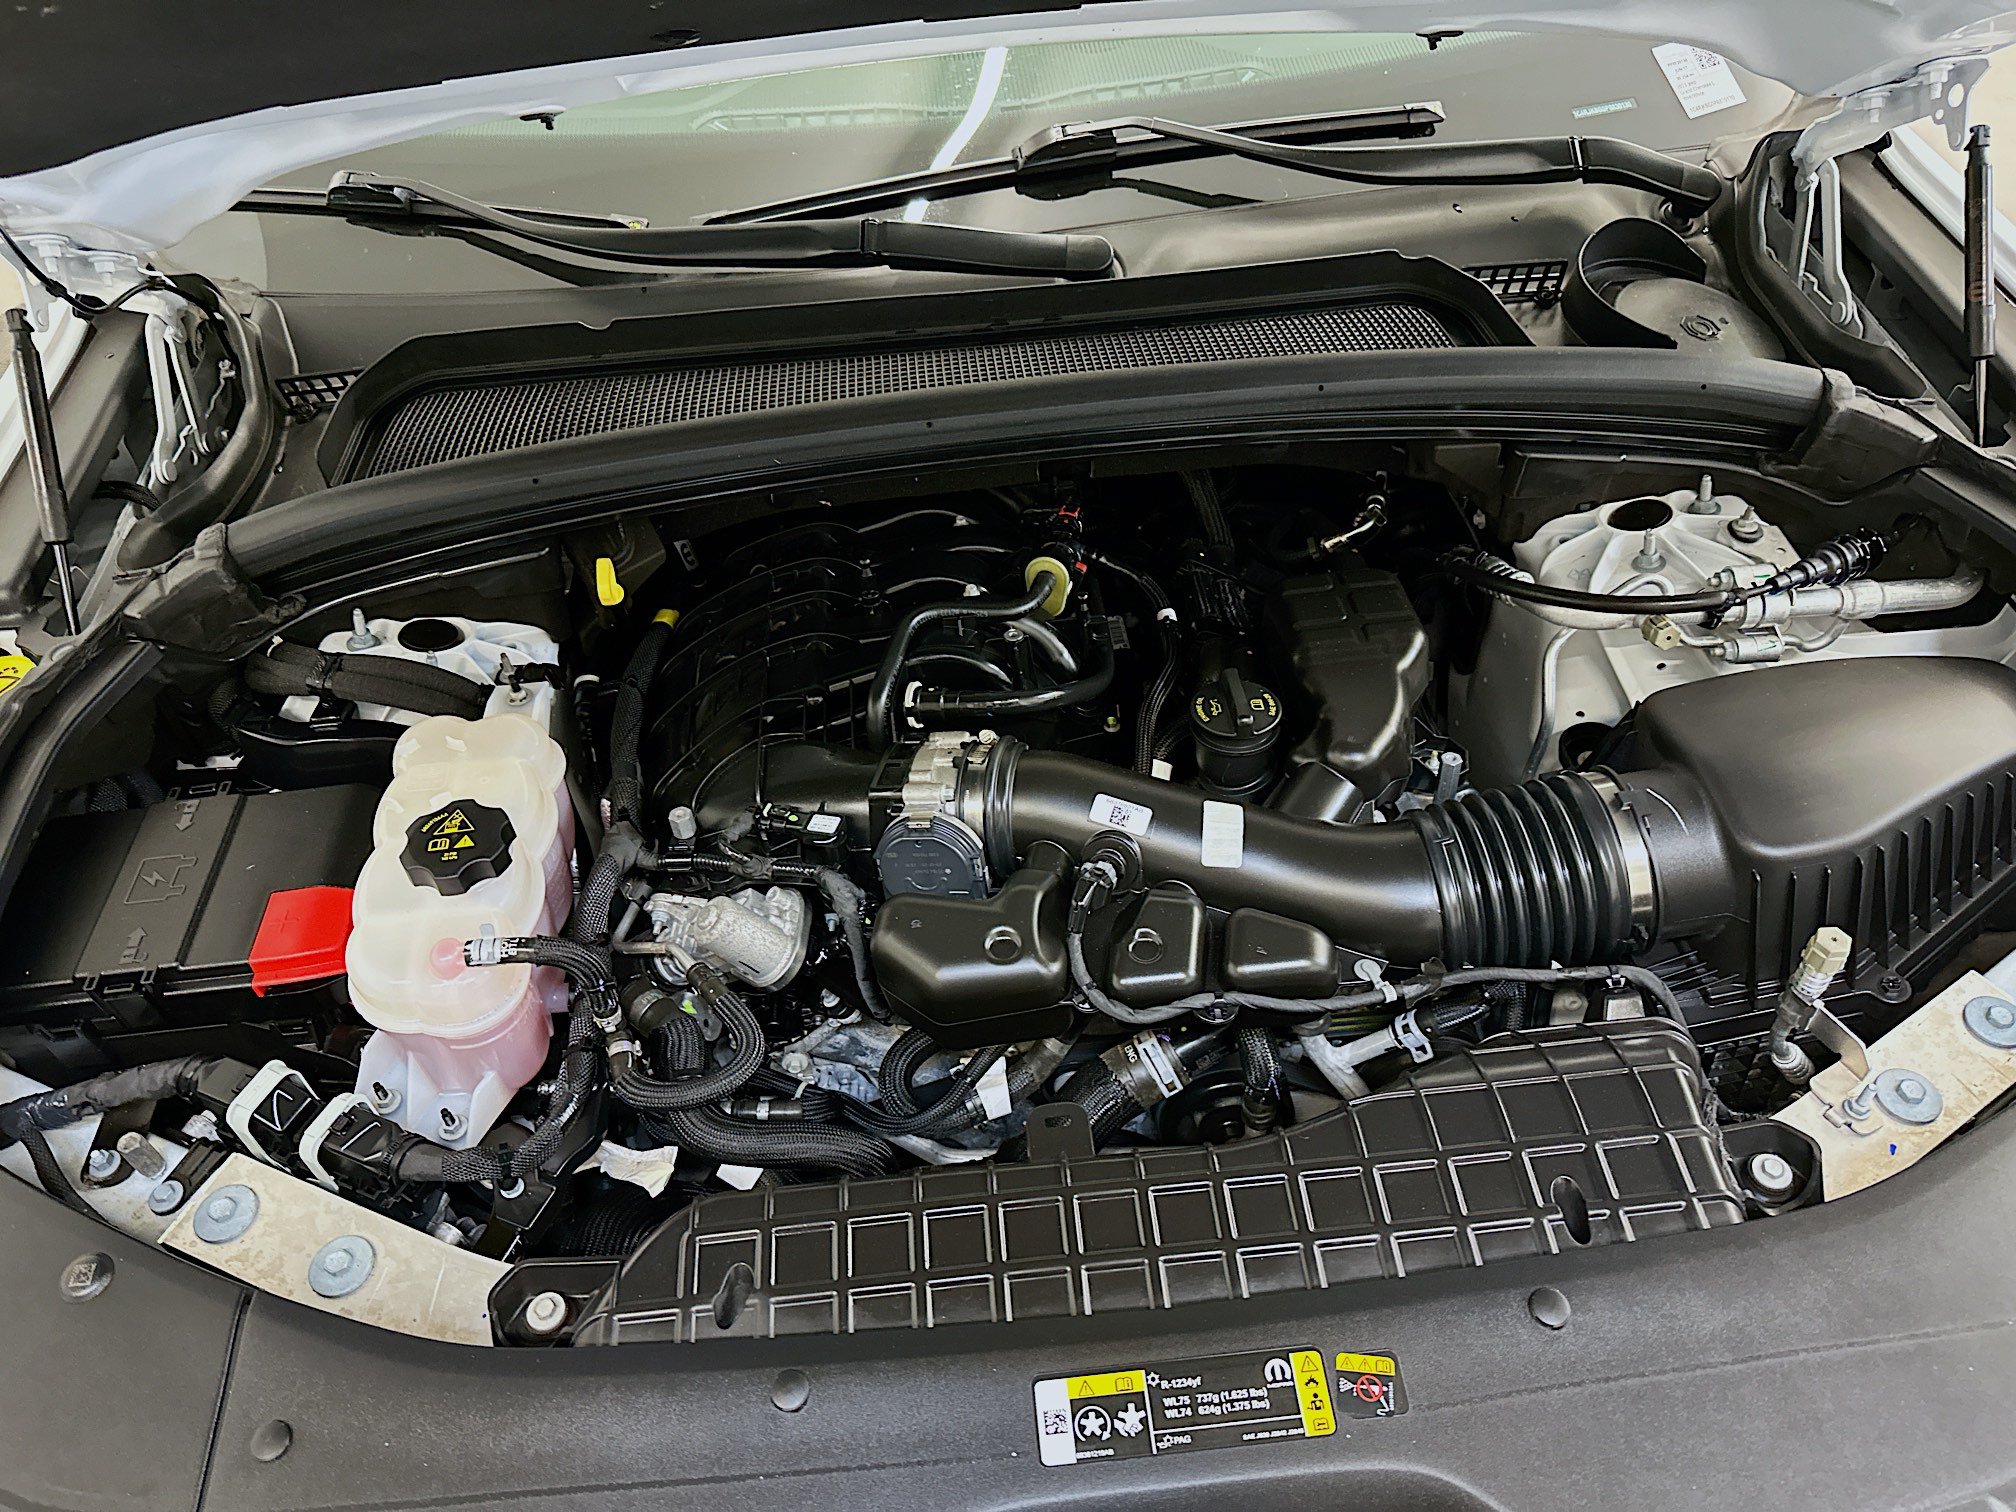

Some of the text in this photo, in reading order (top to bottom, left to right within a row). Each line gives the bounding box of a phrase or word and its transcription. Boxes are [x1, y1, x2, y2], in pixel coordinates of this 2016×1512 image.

[1196, 697, 1210, 722] ENGINE OIL
[1124, 1044, 1138, 1063] ENG
[1160, 1376, 1202, 1389] R-1234yf
[1162, 1386, 1268, 1407] WL75 737g (1.625 lbs)
[1164, 1398, 1271, 1420] WL74 624g (1.375 lbs)
[1173, 1434, 1192, 1445] PAG
